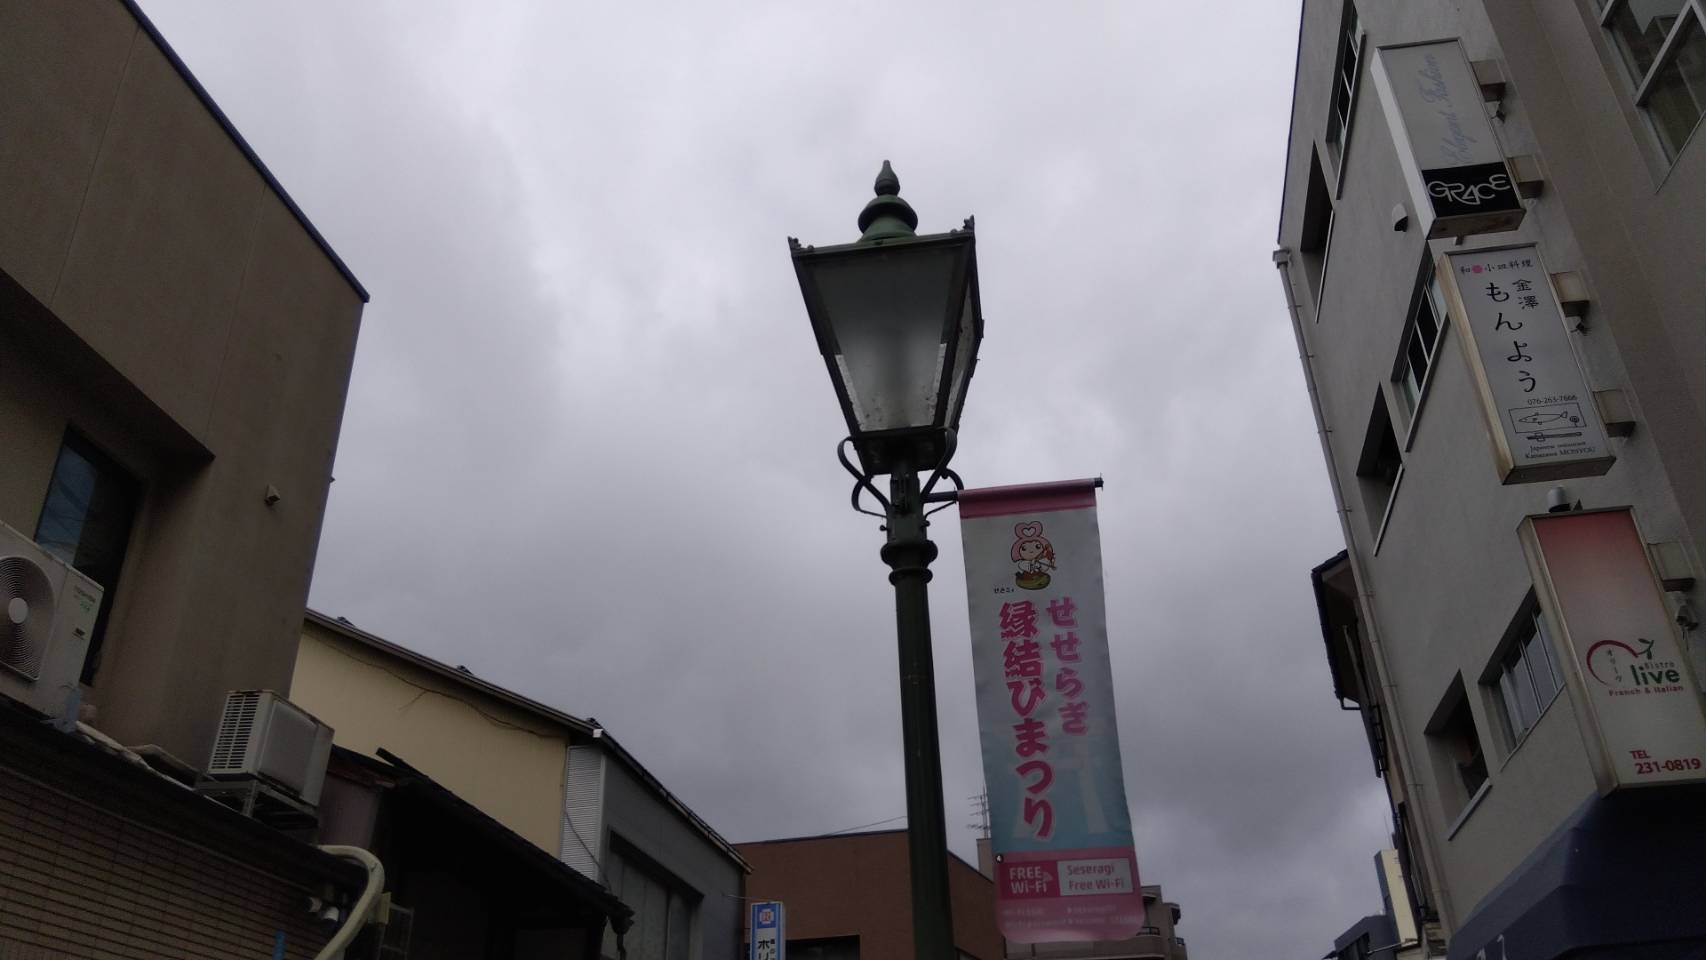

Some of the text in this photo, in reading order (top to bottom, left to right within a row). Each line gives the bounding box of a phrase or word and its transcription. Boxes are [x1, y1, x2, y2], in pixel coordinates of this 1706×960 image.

[1427, 174, 1511, 205] GRACE
[1512, 279, 1539, 310] 金澤
[1486, 282, 1536, 392] もんよう
[1046, 597, 1089, 736] せせらぎ
[1608, 687, 1641, 697] French
[1654, 685, 1684, 694] Italian
[999, 600, 1054, 838] 縁結びまつり
[1630, 750, 1651, 761] TEL
[1635, 758, 1701, 775] 231-0819
[1009, 866, 1042, 881] FREE
[1067, 863, 1115, 876] Seseragi
[1010, 881, 1047, 895] Wi-Fi
[1069, 877, 1125, 891] Free Wi-Fi
